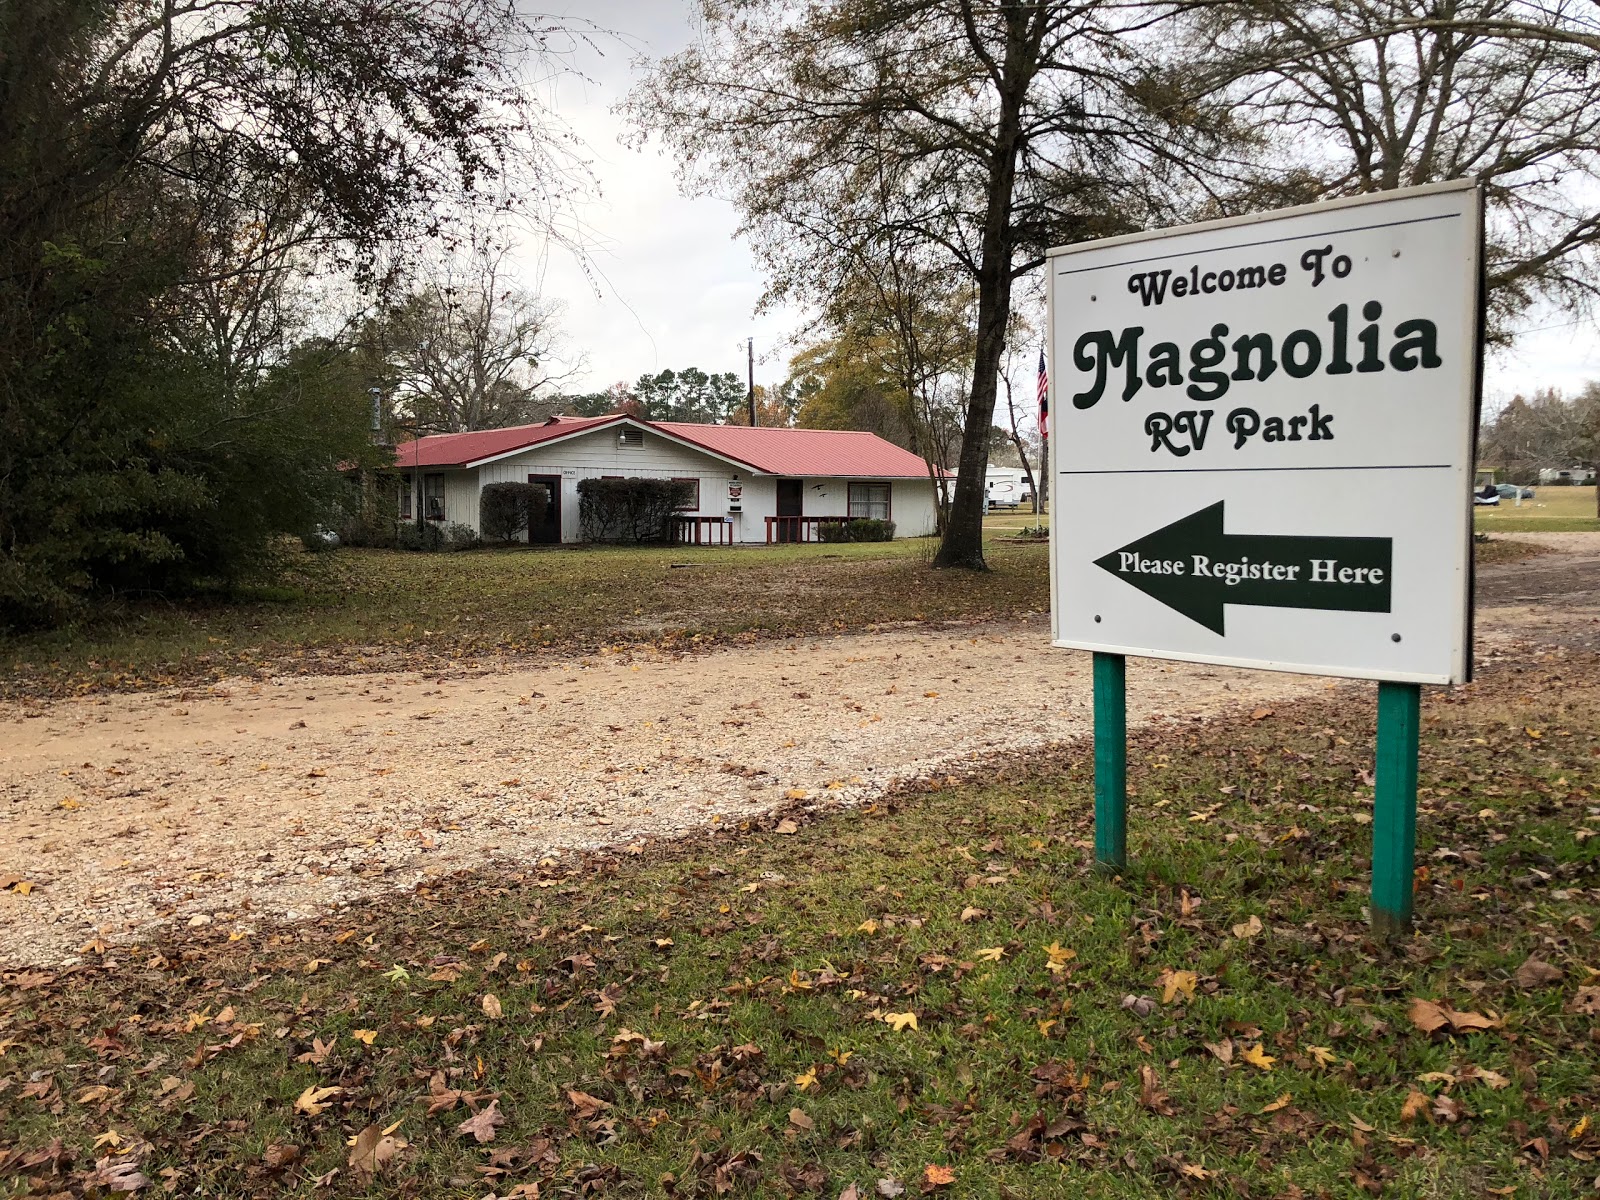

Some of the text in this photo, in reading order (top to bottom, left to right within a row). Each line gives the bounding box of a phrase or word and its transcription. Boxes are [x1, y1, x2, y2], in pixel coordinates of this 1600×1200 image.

[1127, 244, 1353, 307] Welcome To
[1072, 300, 1443, 410] Magnolia
[1144, 403, 1335, 458] RV Park
[1117, 551, 1385, 587] Please Register Here
